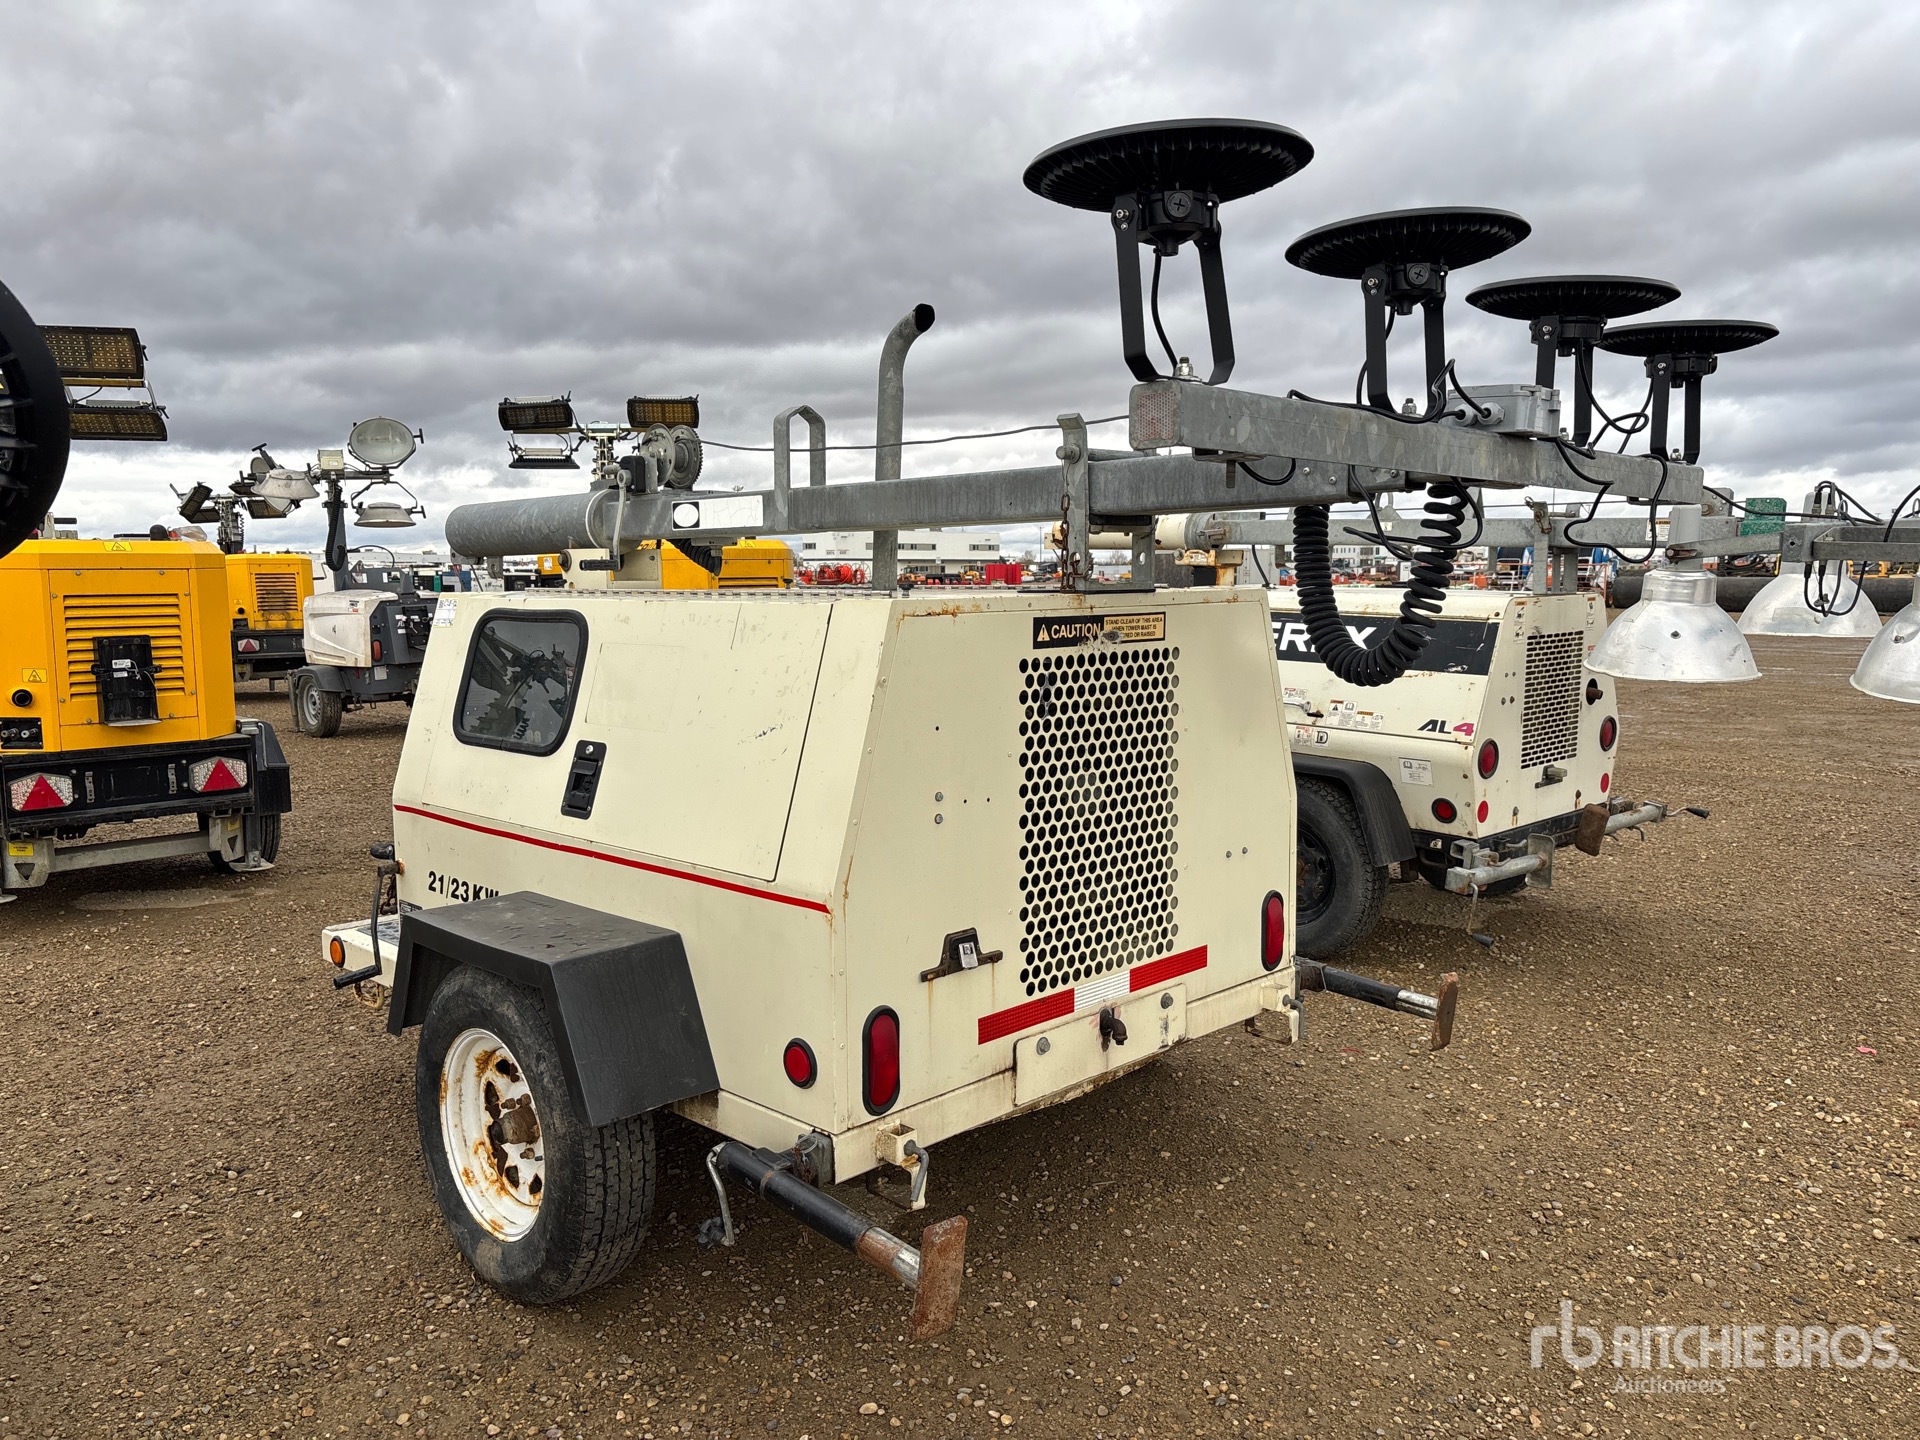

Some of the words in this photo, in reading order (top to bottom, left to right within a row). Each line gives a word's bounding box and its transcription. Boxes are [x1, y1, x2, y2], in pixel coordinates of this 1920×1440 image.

[1051, 622, 1101, 639] CAUTION
[1417, 719, 1475, 737] AL4
[428, 870, 469, 903] 21/23
